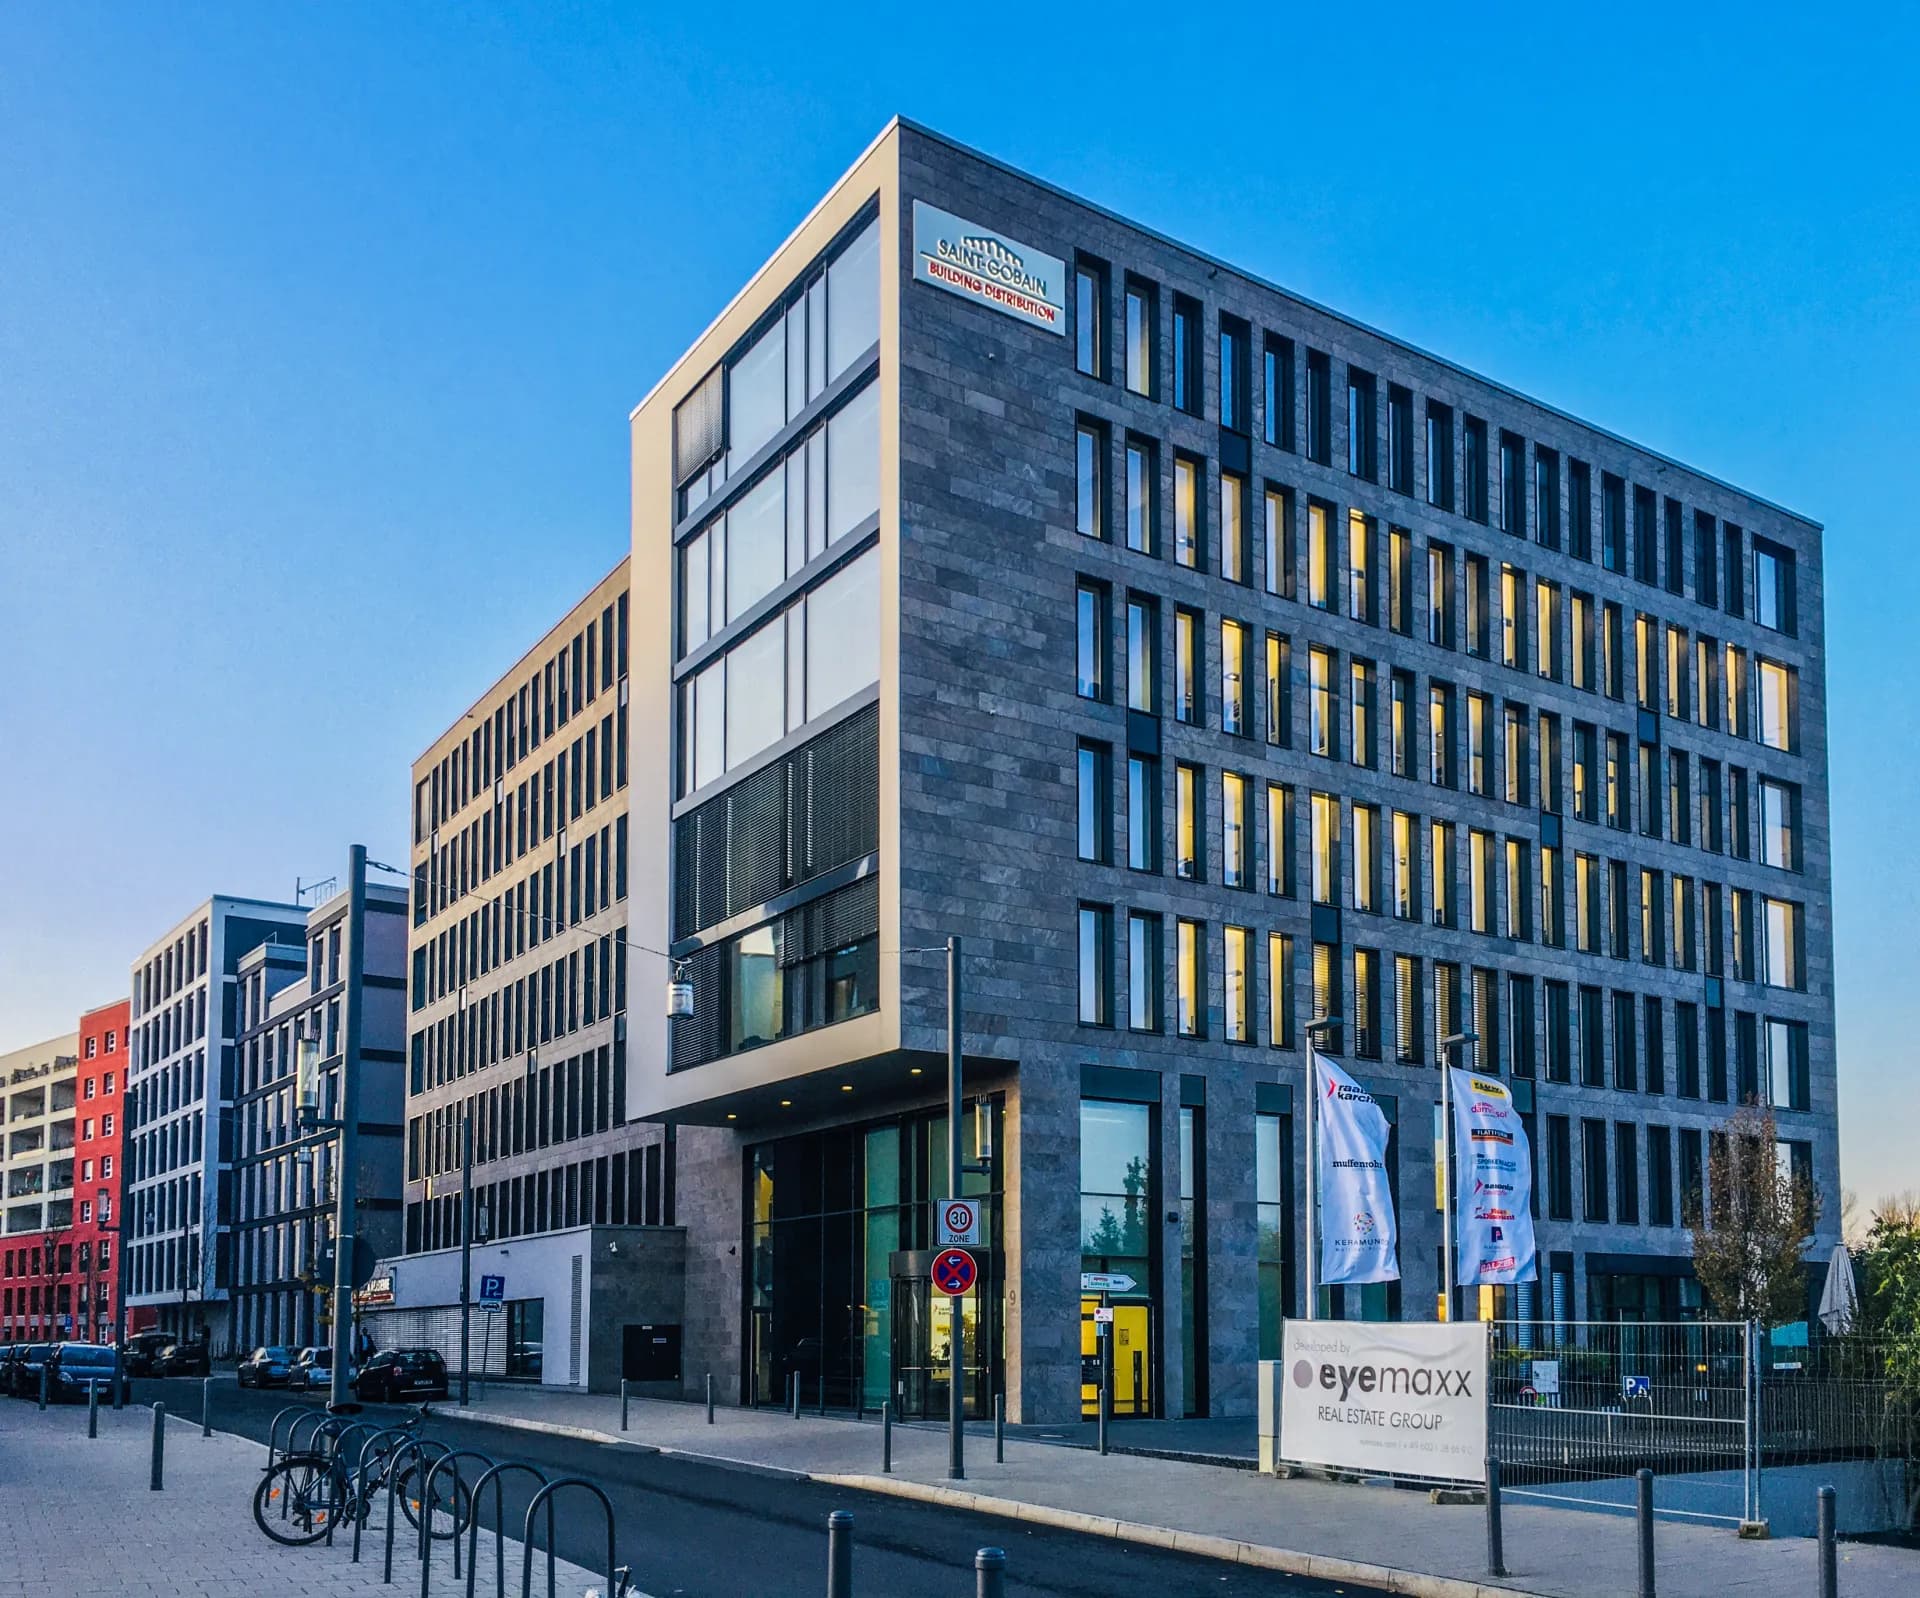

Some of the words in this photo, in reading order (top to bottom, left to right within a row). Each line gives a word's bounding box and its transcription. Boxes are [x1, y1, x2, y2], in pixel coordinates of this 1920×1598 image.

[938, 238, 1047, 297] SAINT-GOBAIN
[928, 261, 982, 292] BUILDING
[985, 284, 1055, 322] DISTRIBUTION
[1337, 1091, 1377, 1104] karch
[951, 1211, 968, 1225] 30
[948, 1234, 970, 1243] ZONE
[1335, 1238, 1389, 1247] KERAMUN
[486, 1279, 499, 1297] P
[1009, 1290, 1016, 1305] 9
[1319, 1362, 1473, 1401] eyemaxx
[1626, 1378, 1636, 1394] P
[1318, 1405, 1343, 1423] REAL
[1347, 1408, 1385, 1427] ESTATE
[1390, 1411, 1443, 1430] GROUP
